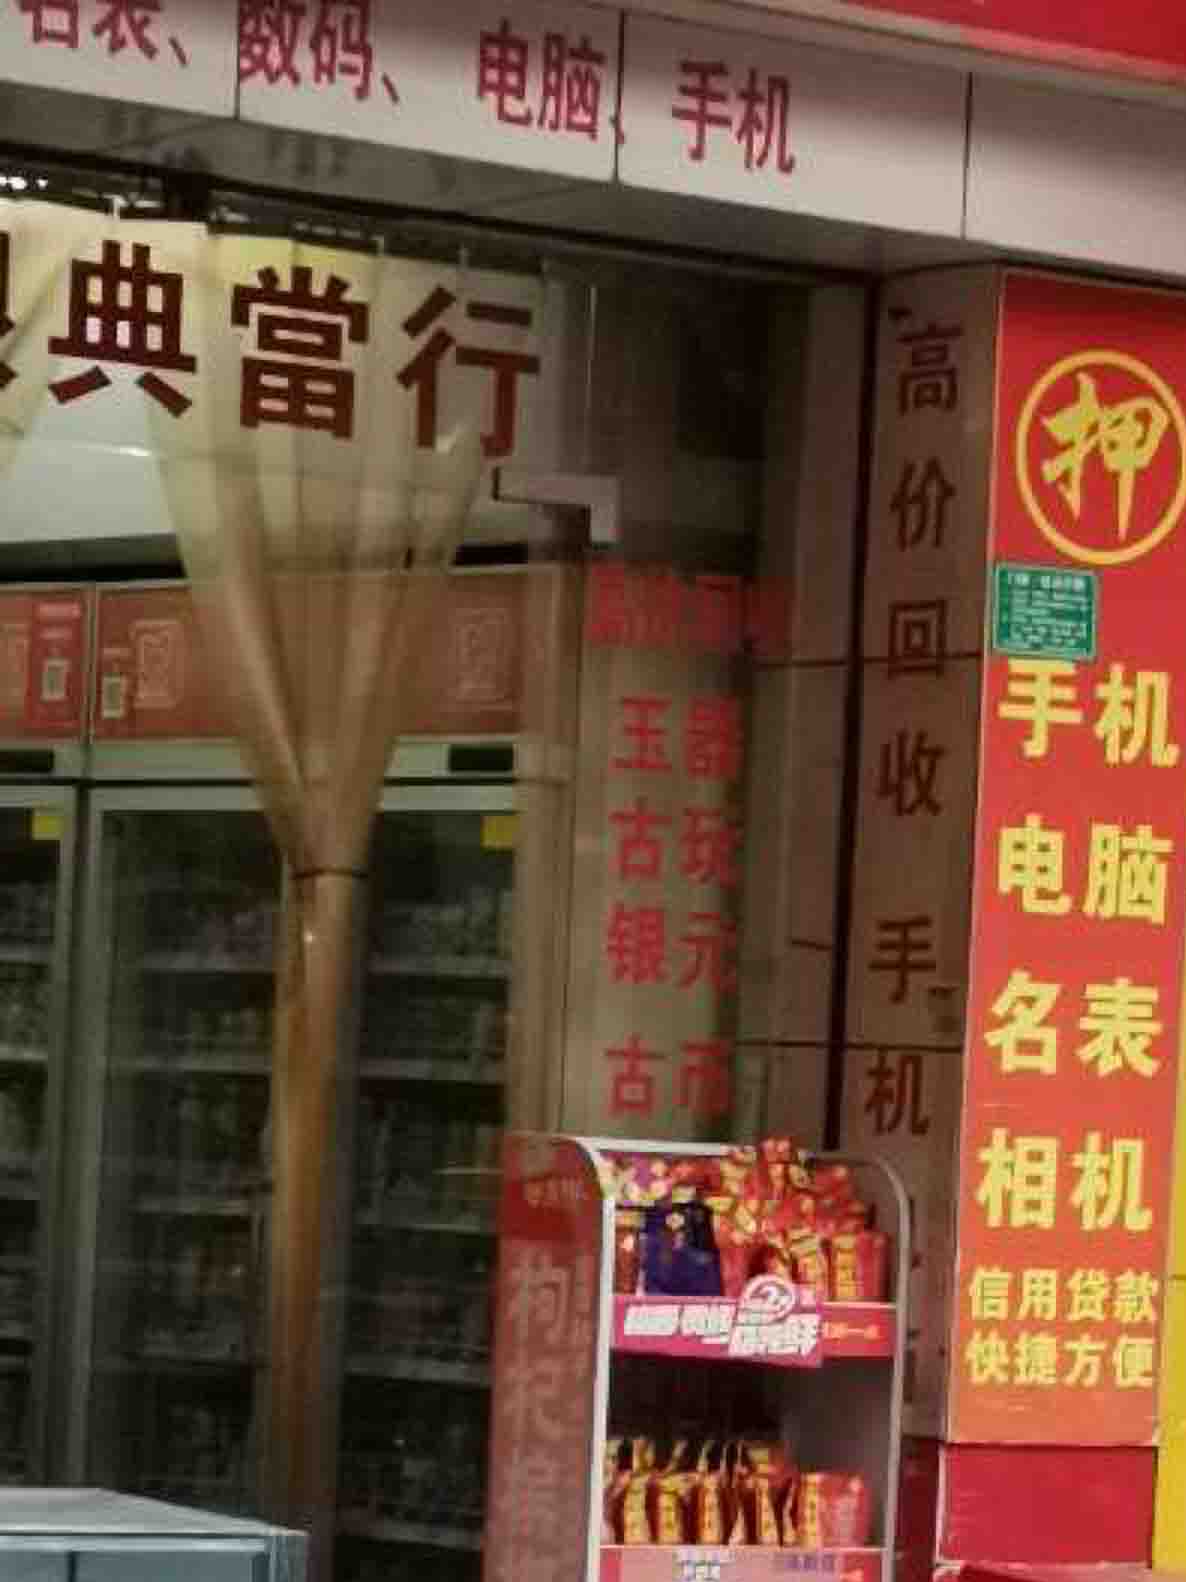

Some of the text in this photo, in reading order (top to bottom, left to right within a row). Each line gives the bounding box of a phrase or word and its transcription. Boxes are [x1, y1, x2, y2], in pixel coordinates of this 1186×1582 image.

[0, 228, 541, 459] 典當行
[1041, 371, 1169, 542] 押
[998, 659, 1180, 768] 手机
[997, 814, 1175, 925] 电脑
[984, 969, 1163, 1078] 名表
[976, 1127, 1154, 1233] 相机
[968, 1265, 1160, 1326] 信用贷款
[965, 1333, 1155, 1390] 快捷方便
